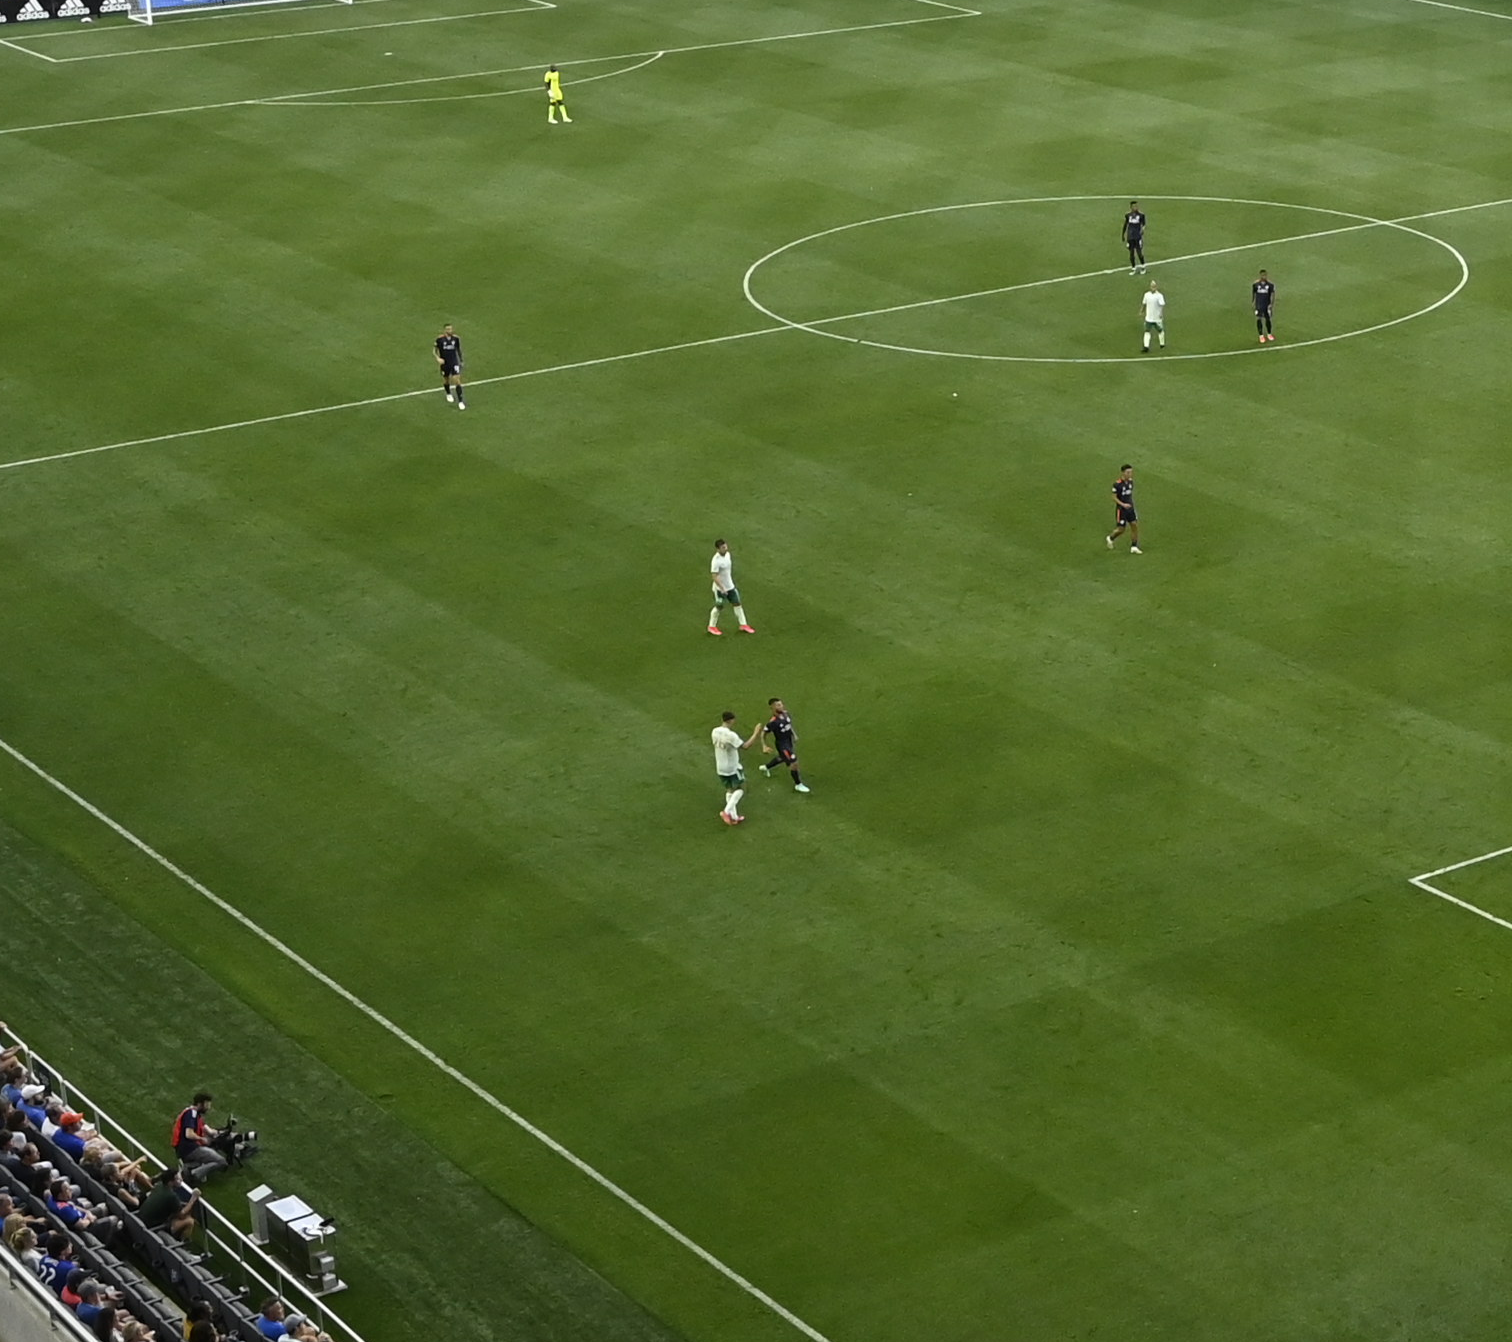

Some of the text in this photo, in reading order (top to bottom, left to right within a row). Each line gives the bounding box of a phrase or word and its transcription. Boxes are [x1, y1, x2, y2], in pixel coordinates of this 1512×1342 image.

[57, 5, 90, 18] adidas
[99, 1, 131, 14] adidas
[16, 9, 50, 22] adidas
